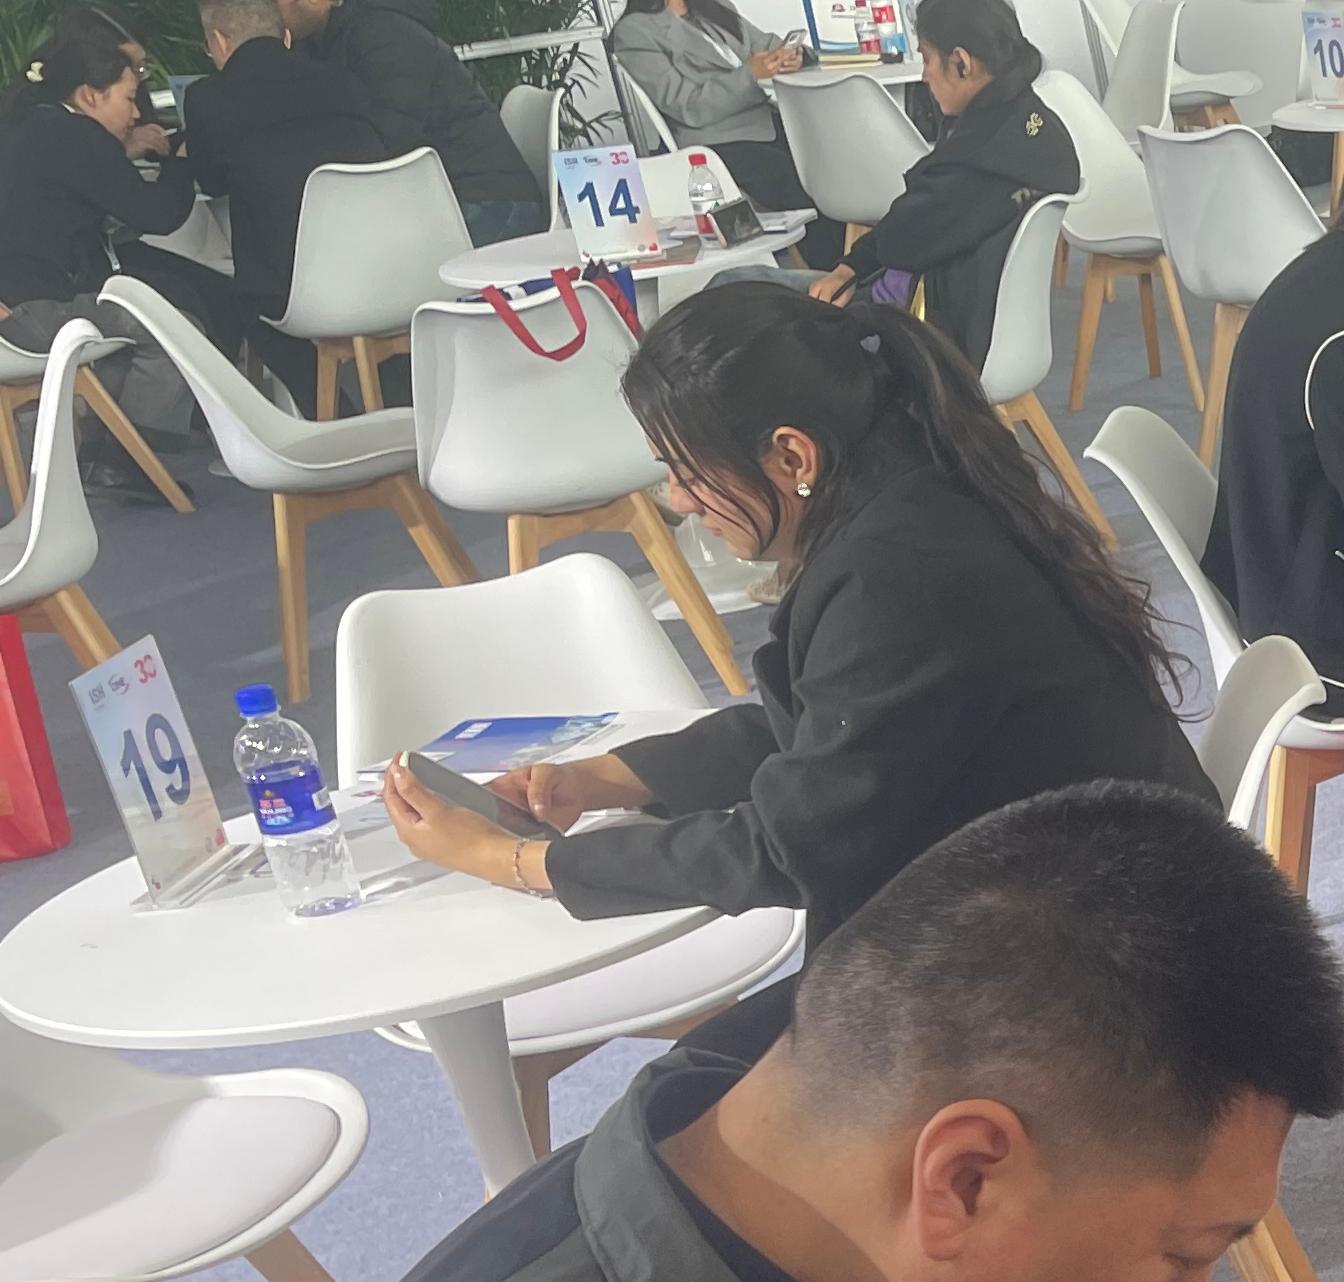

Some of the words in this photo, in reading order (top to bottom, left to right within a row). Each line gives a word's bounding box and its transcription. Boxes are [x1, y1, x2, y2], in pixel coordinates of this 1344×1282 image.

[1313, 39, 1344, 78] 10
[577, 178, 641, 228] 14
[120, 713, 191, 822] 19
